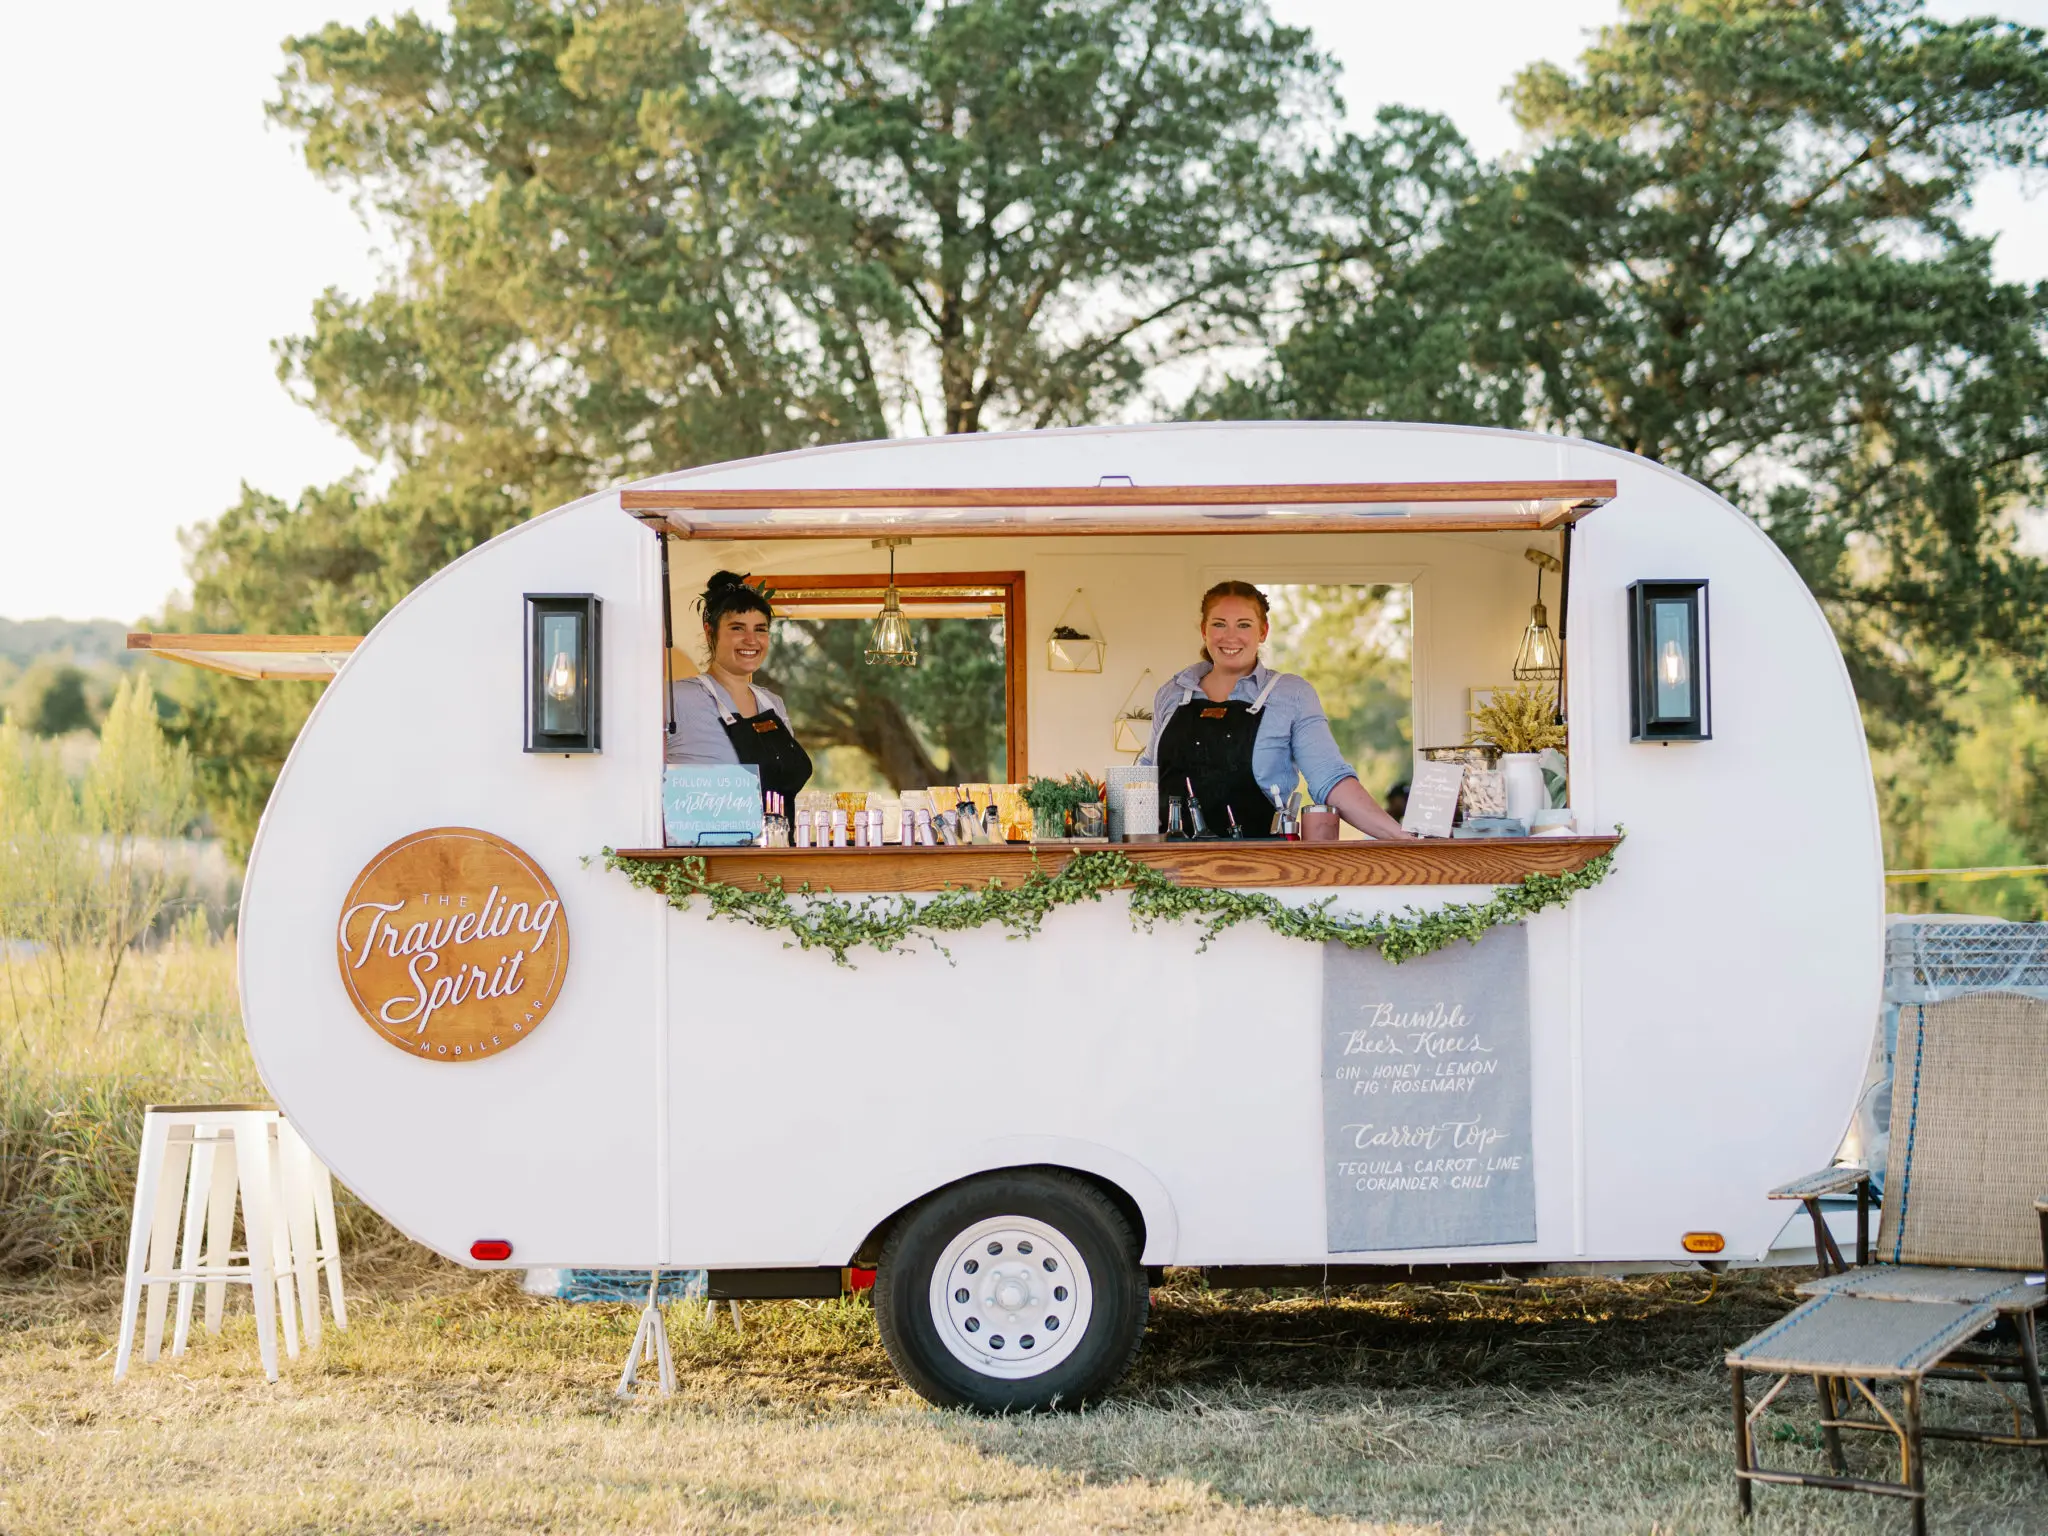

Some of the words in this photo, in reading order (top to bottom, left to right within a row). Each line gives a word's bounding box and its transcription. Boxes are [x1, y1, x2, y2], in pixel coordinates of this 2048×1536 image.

[671, 776, 712, 788] FOLLOW
[717, 776, 731, 788] US
[735, 776, 750, 788] ON
[668, 791, 756, 818] instagram
[422, 893, 468, 908] THE
[340, 885, 559, 969] Traveling
[380, 950, 525, 1034] Spirit
[421, 1035, 502, 1055] MOBILE
[513, 999, 543, 1032] BAR
[1361, 1002, 1475, 1028] Bumble
[1339, 1029, 1403, 1056] Bee's
[1407, 1032, 1494, 1058] Knees
[1335, 1065, 1361, 1080] GIN
[1372, 1063, 1421, 1079] HONEY
[1435, 1059, 1498, 1077] LEMON
[1353, 1080, 1380, 1095] FIG
[1391, 1077, 1476, 1094] ROSEMARY
[1341, 1123, 1446, 1150] Carrot
[1442, 1113, 1510, 1153] Top
[1337, 1161, 1403, 1176] TEQUILA
[1414, 1158, 1477, 1174] CARROT
[1486, 1156, 1522, 1172] LIME
[1356, 1175, 1439, 1191] CORIANDER
[1451, 1174, 1491, 1189] CHILI
